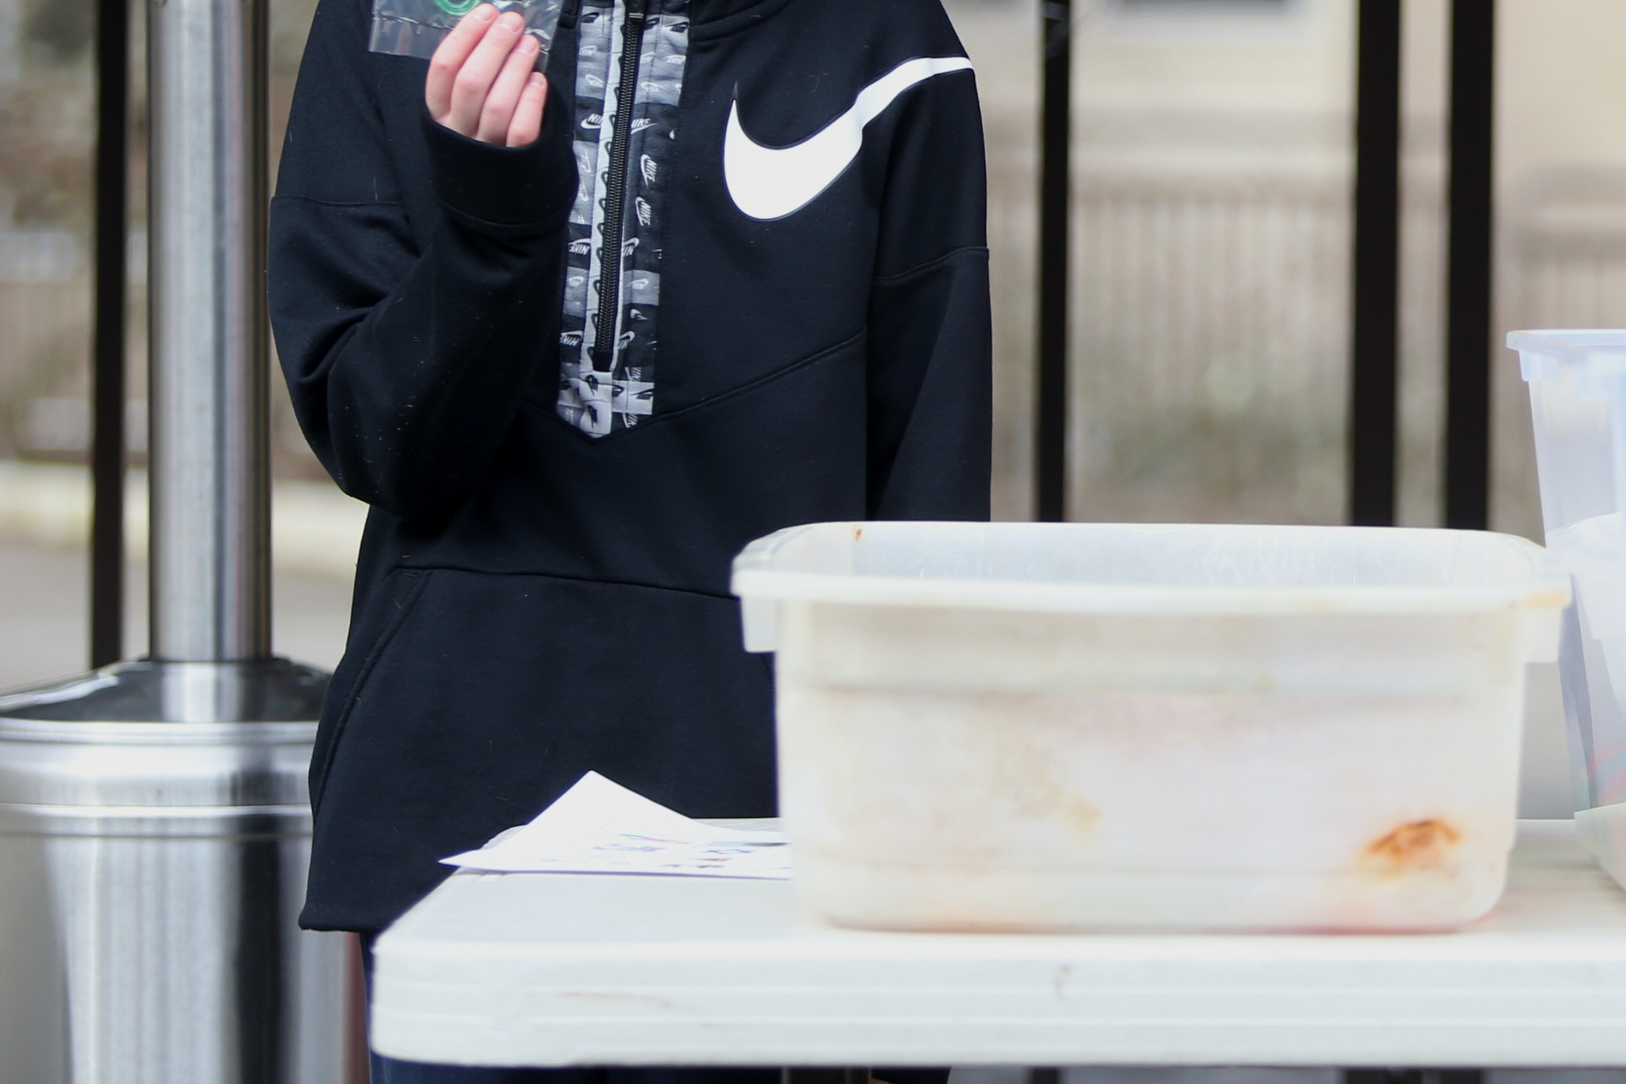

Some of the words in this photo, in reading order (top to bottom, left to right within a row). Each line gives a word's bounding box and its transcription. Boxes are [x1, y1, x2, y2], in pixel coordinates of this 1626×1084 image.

[644, 158, 658, 183] NIKE
[640, 201, 652, 226] NIKE
[569, 244, 590, 255] NIKE
